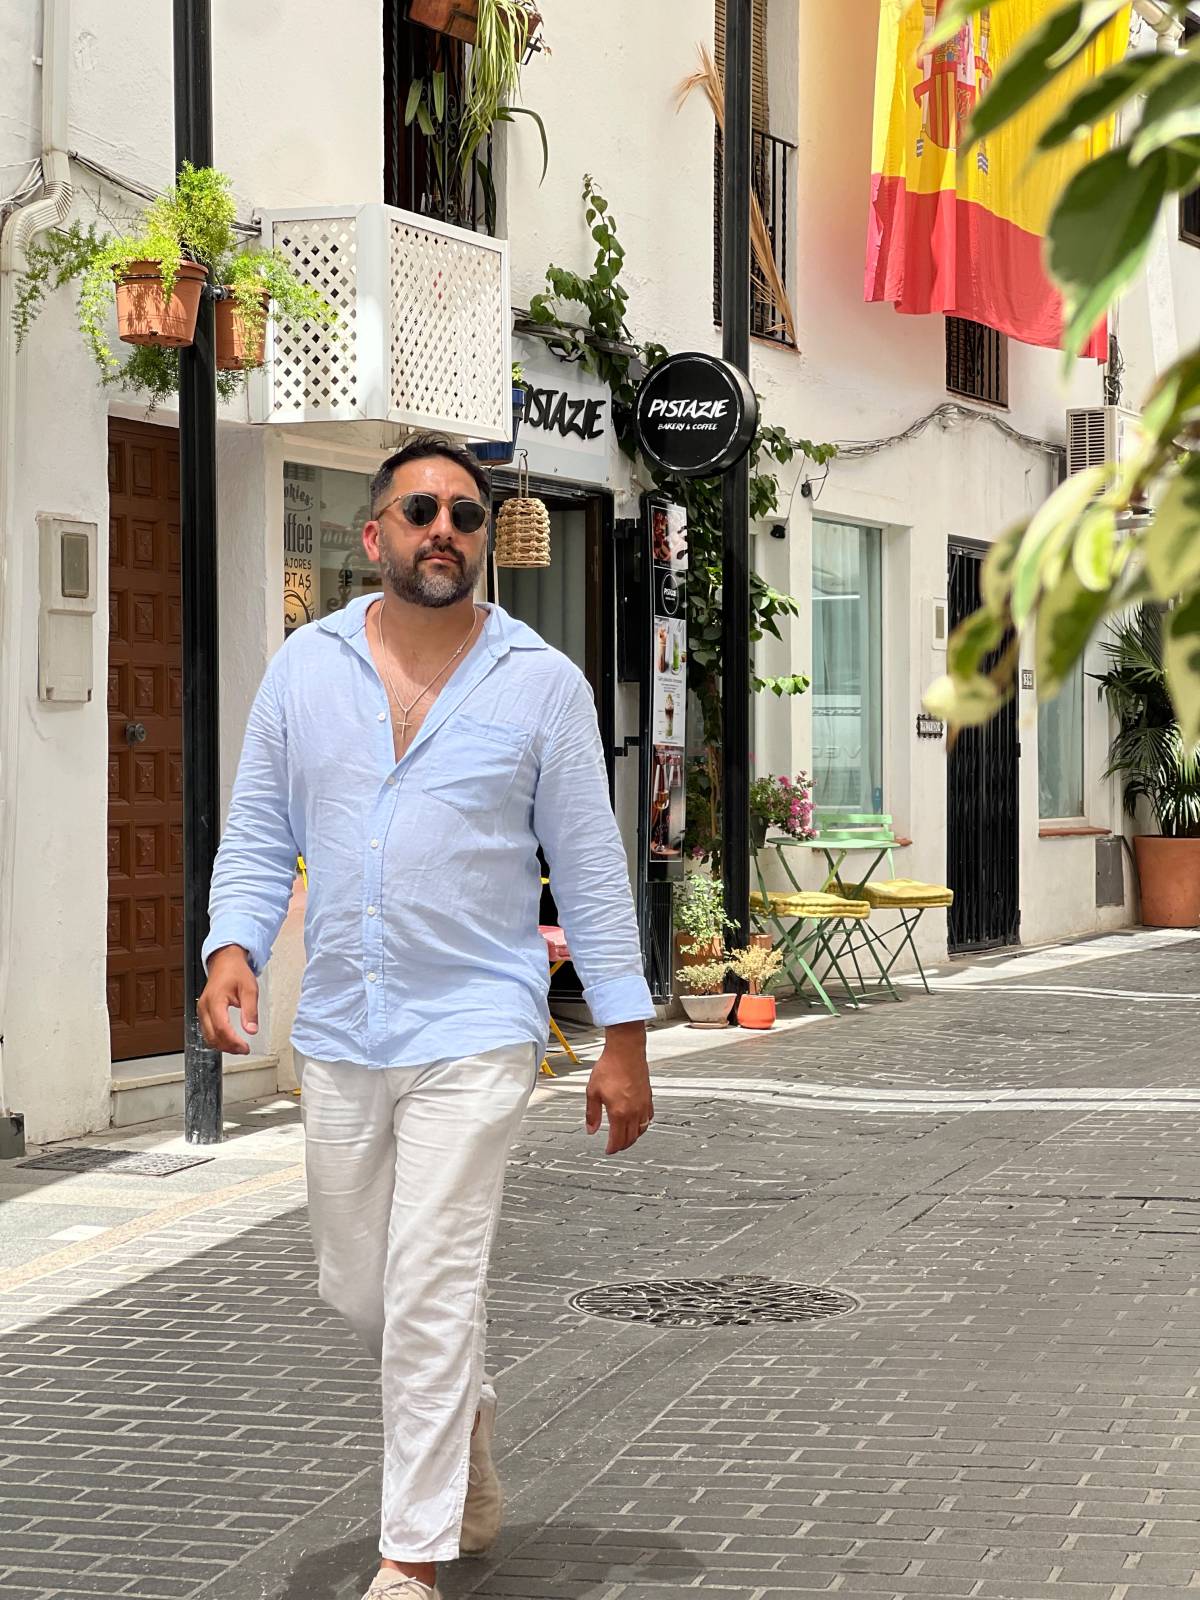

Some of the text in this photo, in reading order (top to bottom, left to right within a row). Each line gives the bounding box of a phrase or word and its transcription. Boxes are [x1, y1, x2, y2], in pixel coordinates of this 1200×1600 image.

[521, 381, 607, 440] ISTAZIE
[647, 398, 730, 419] PISTAZIE
[657, 422, 686, 431] BAKERY
